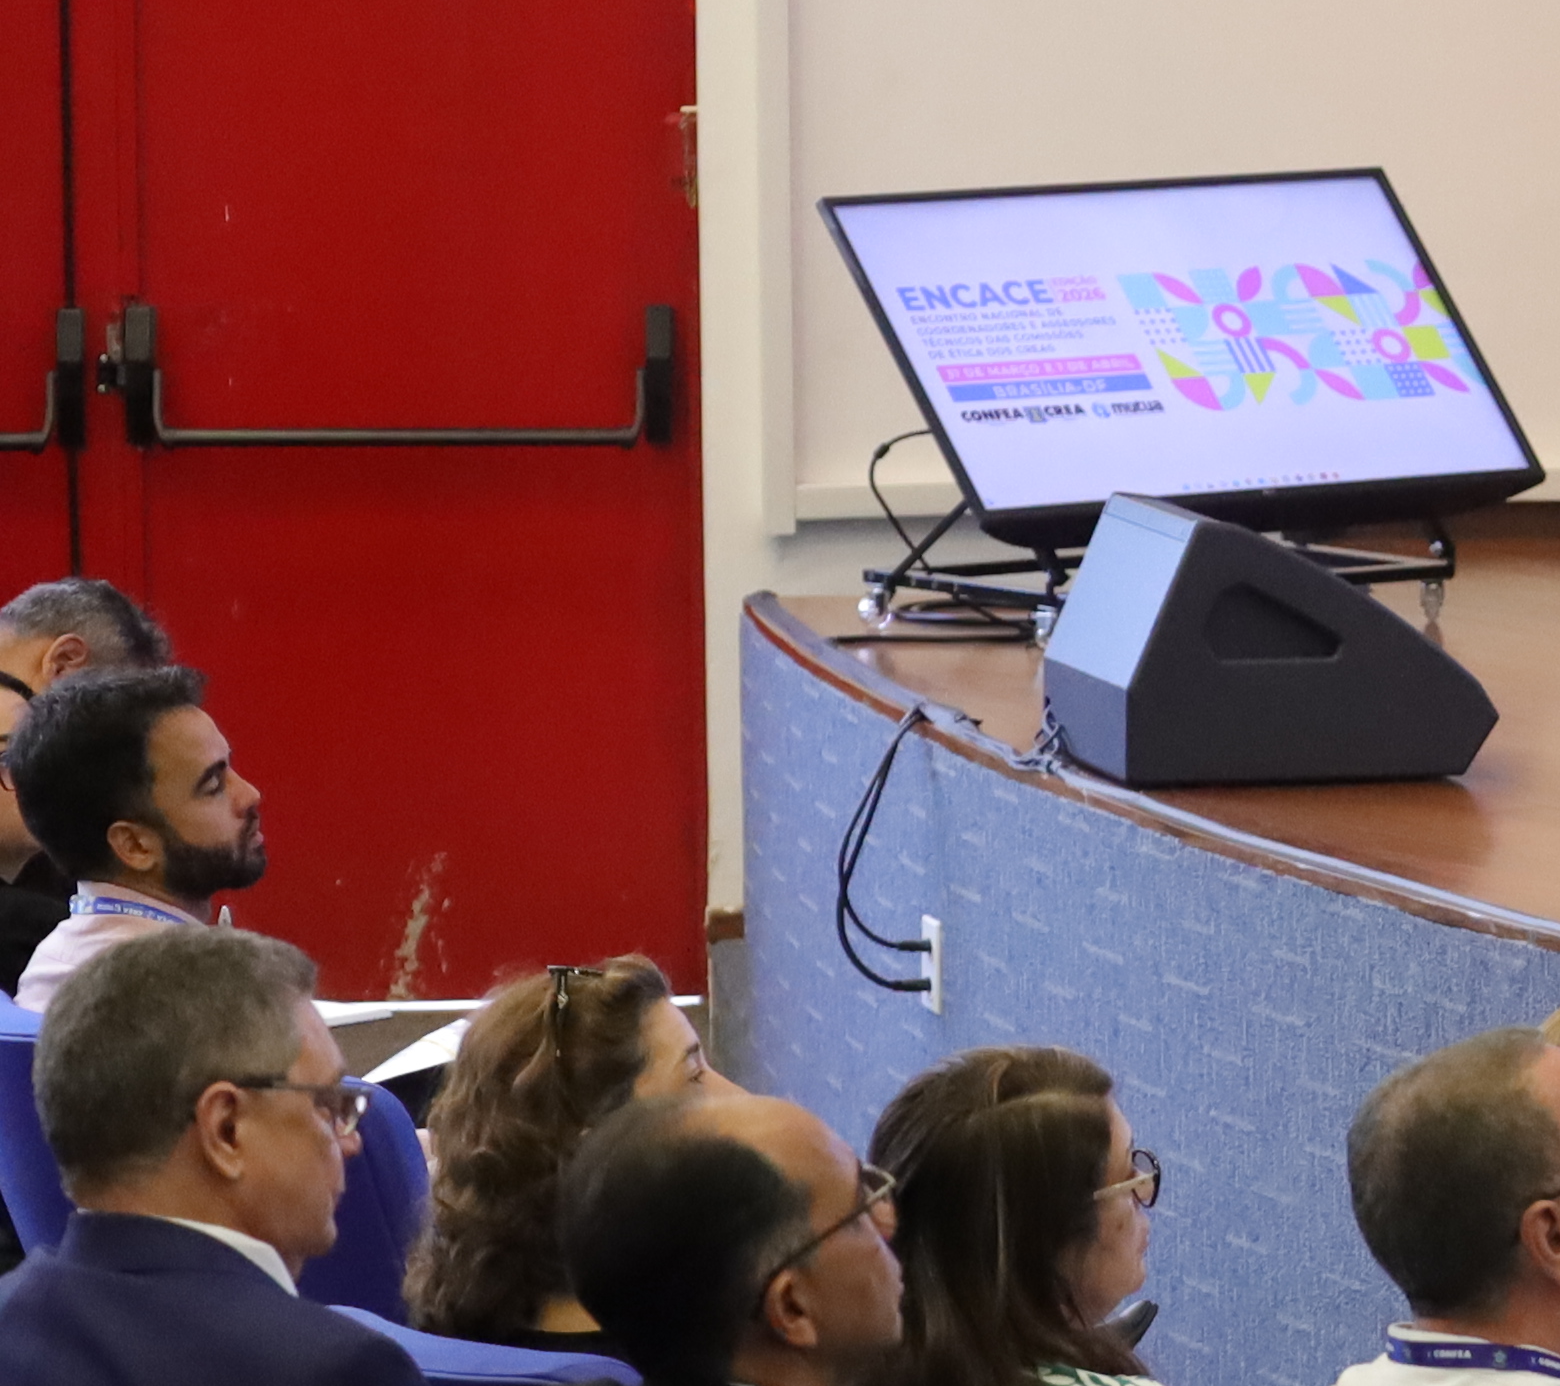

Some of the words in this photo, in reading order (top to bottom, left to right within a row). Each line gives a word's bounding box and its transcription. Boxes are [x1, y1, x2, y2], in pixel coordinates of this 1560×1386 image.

[895, 279, 1054, 312] ENCACE
[1058, 286, 1107, 303] 2026
[960, 407, 1024, 422] CONFEA
[1044, 404, 1086, 417] CREA
